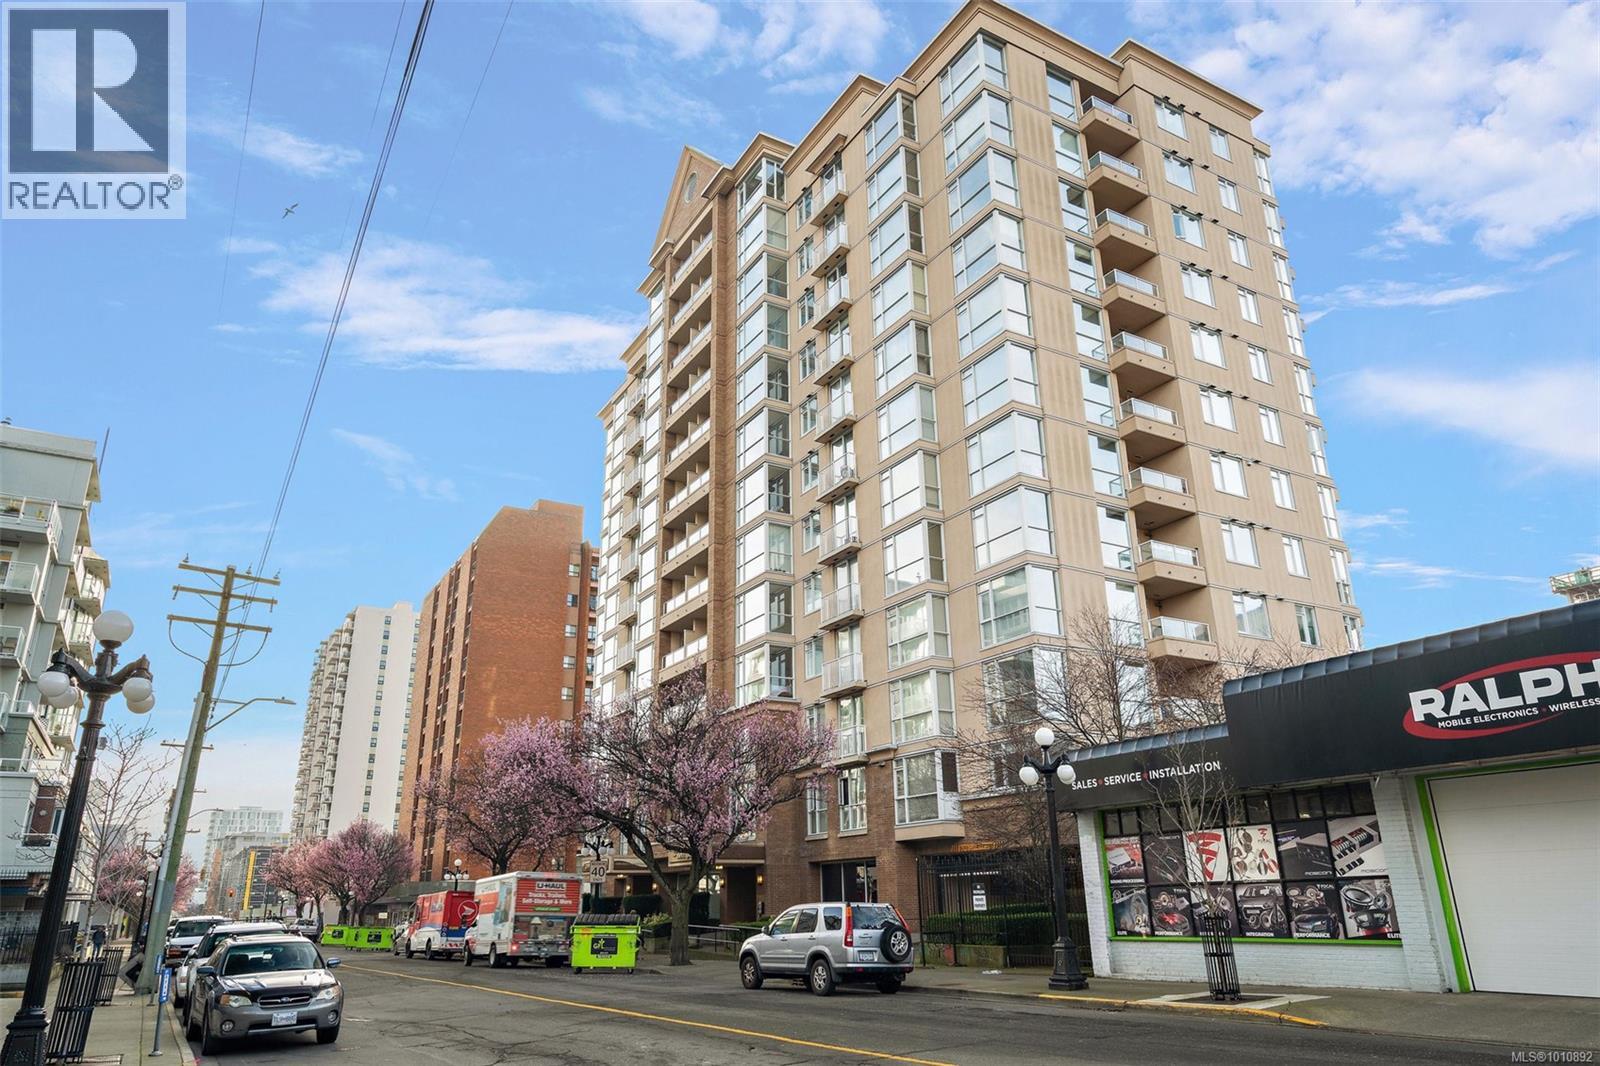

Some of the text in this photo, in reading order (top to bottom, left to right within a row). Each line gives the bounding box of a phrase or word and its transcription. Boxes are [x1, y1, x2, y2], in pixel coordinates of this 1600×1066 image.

[1438, 696, 1600, 728] MOBILE ELECTRONICS WIRELESS
[1071, 760, 1222, 791] SALES SERVICE INSTALLATON
[592, 866, 605, 877] 40
